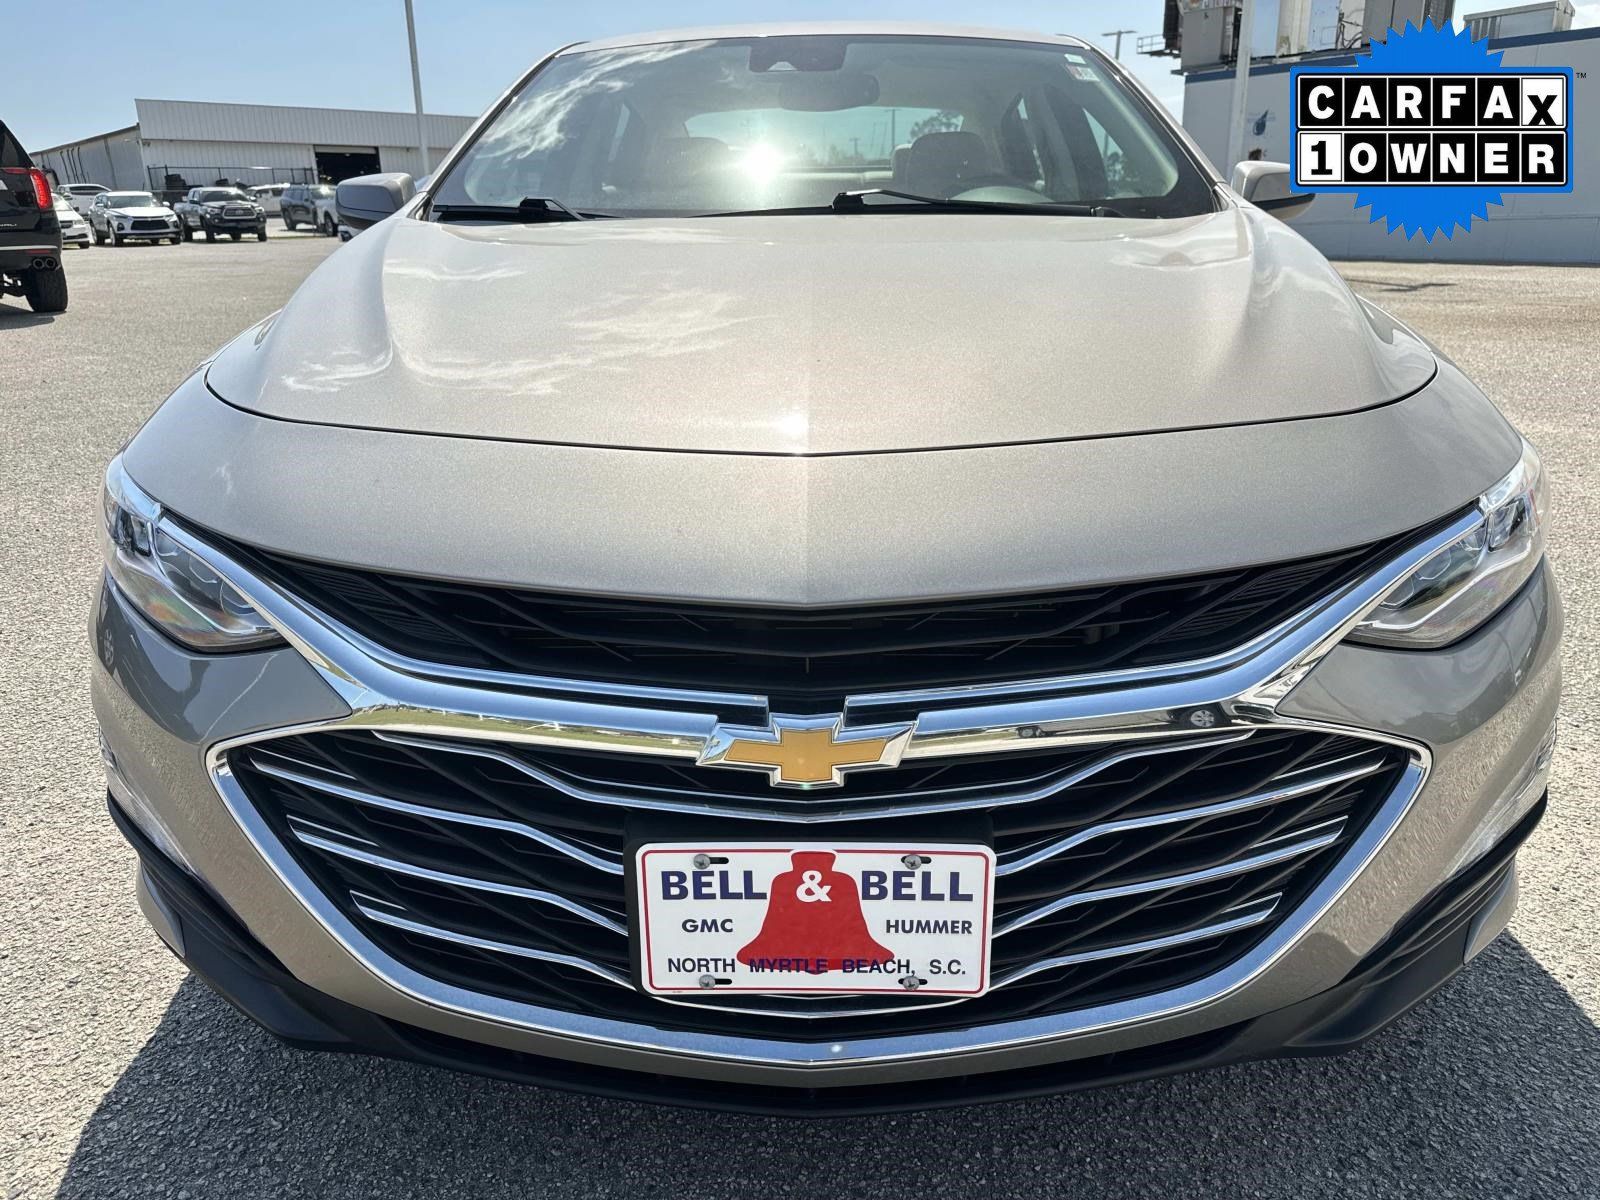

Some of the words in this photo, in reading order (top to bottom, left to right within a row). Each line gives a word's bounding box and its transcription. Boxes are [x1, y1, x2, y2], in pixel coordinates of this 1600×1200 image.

[661, 870, 767, 900] BELL
[795, 870, 832, 903] &
[861, 870, 973, 902] BELL
[681, 918, 734, 933] GMC
[886, 919, 973, 935] HUMMER
[668, 958, 735, 973] NORTH
[749, 958, 828, 973] MYRTLE
[842, 959, 916, 976] BEACH,
[929, 959, 966, 975] S.C.
